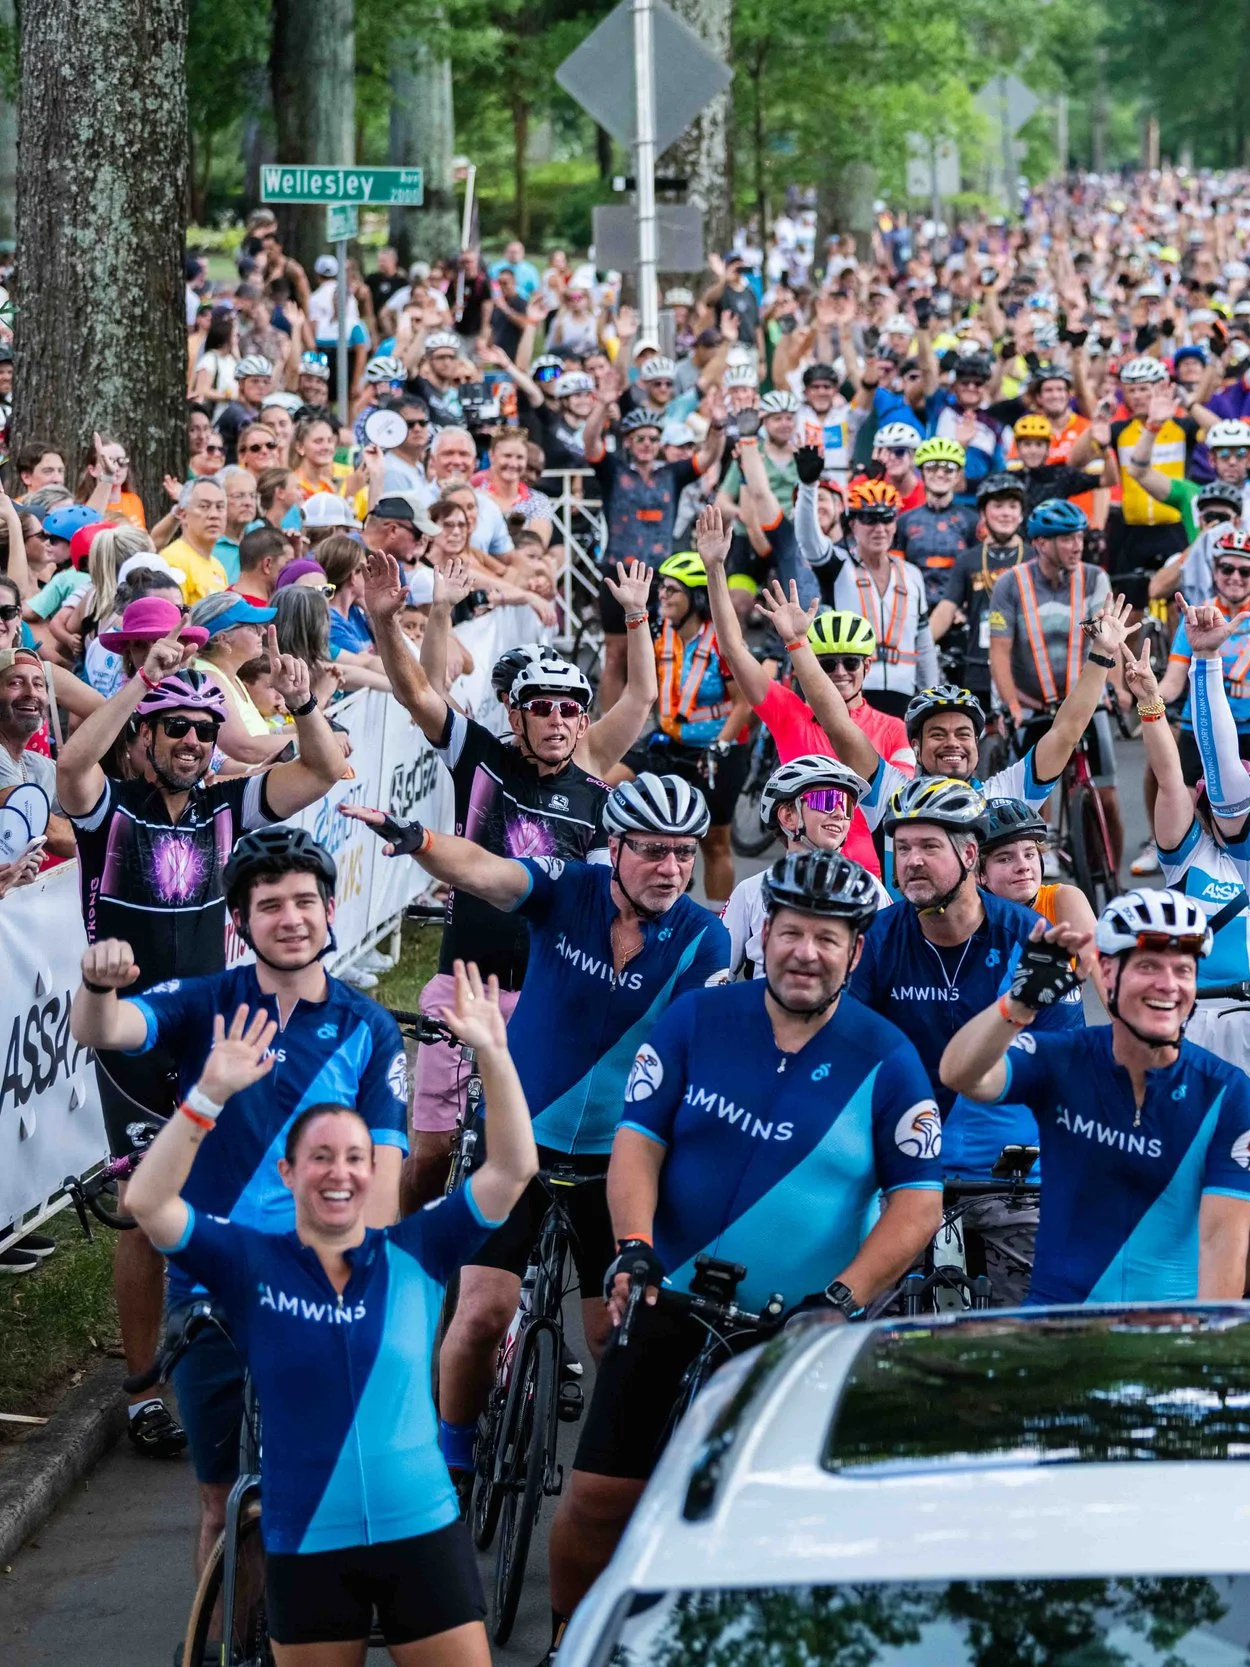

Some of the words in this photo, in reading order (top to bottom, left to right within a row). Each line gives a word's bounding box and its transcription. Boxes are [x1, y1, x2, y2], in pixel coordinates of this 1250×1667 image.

[265, 169, 374, 201] Wellesley
[1202, 728, 1212, 755] MEMORY
[1207, 756, 1217, 784] LOVING
[555, 933, 644, 990] AMWINS
[890, 986, 960, 1001] AMWINS
[0, 990, 72, 1109] ASSA
[683, 1084, 794, 1141] AMWINS
[1056, 1104, 1162, 1158] AMWINS
[257, 1282, 367, 1324] AMWINS
